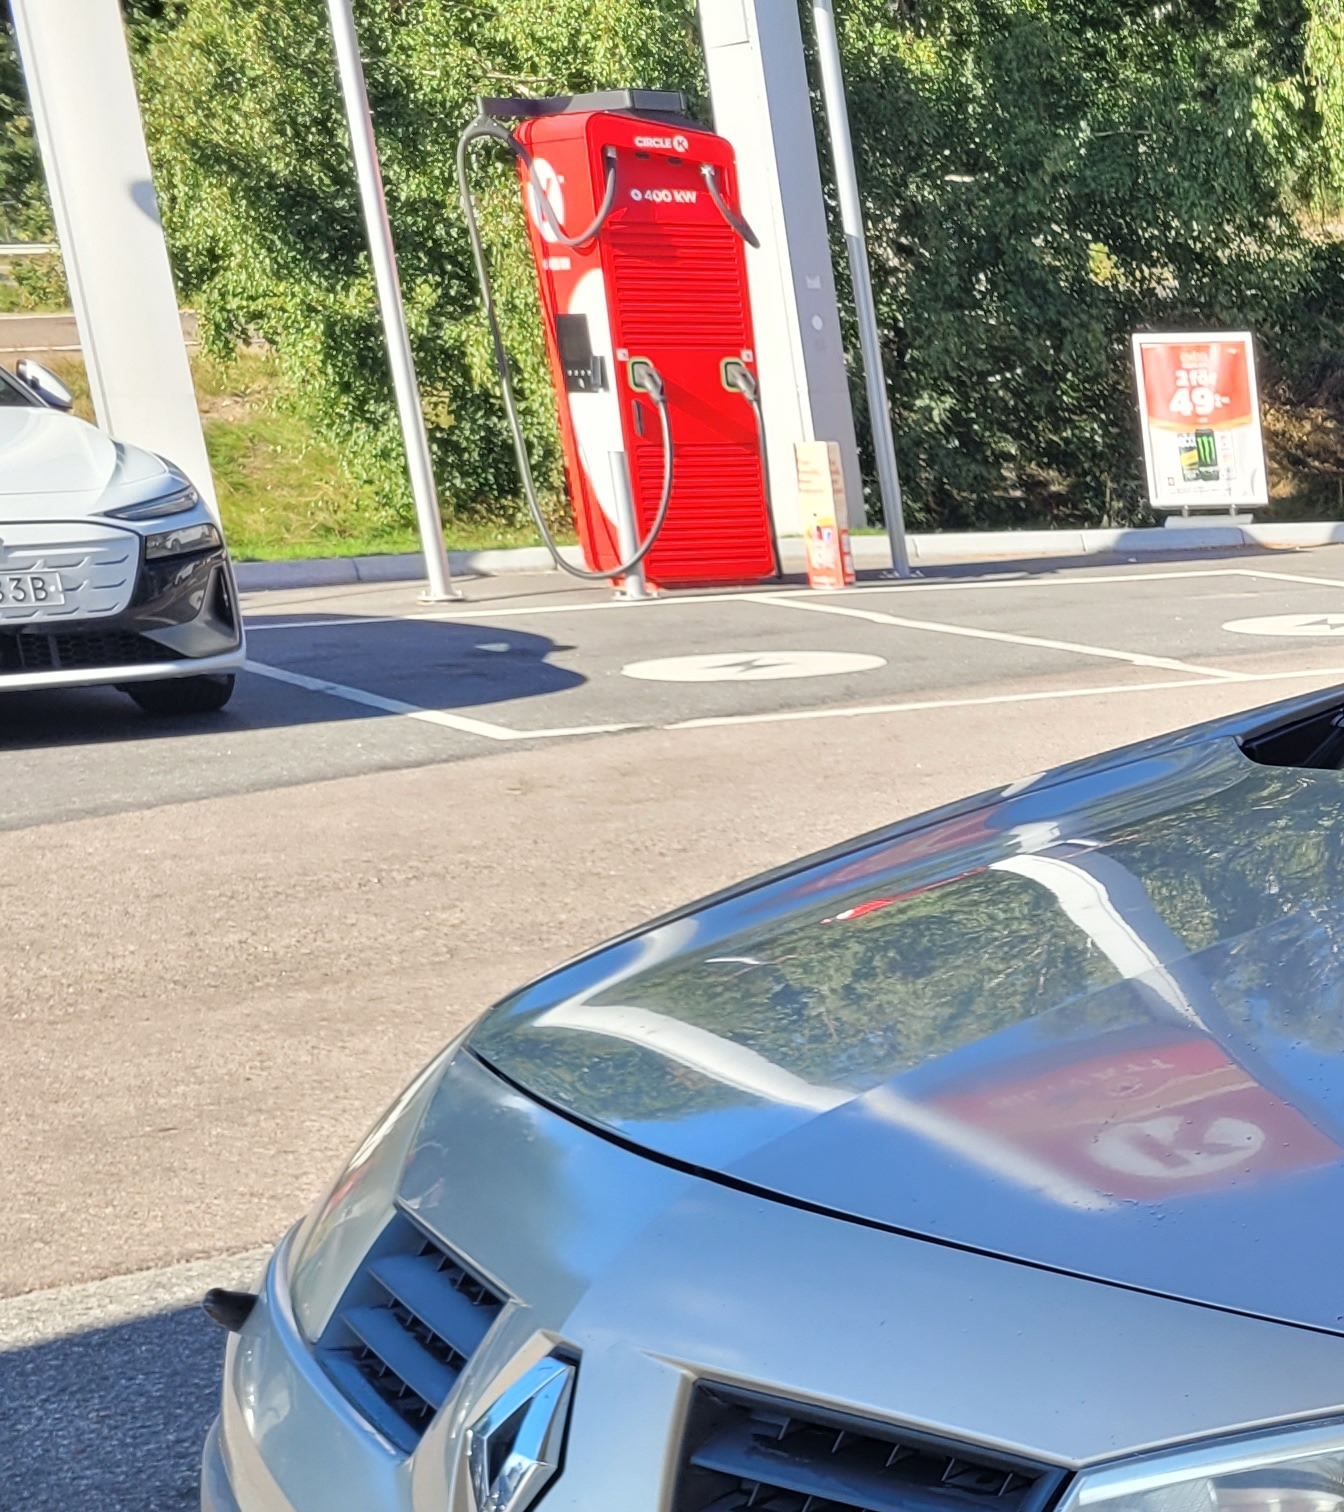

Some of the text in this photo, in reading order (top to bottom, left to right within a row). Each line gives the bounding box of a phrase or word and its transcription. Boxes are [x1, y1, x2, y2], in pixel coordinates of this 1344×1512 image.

[634, 136, 672, 149] CIRCLE
[644, 188, 672, 202] 400
[0, 576, 48, 603] 3B
